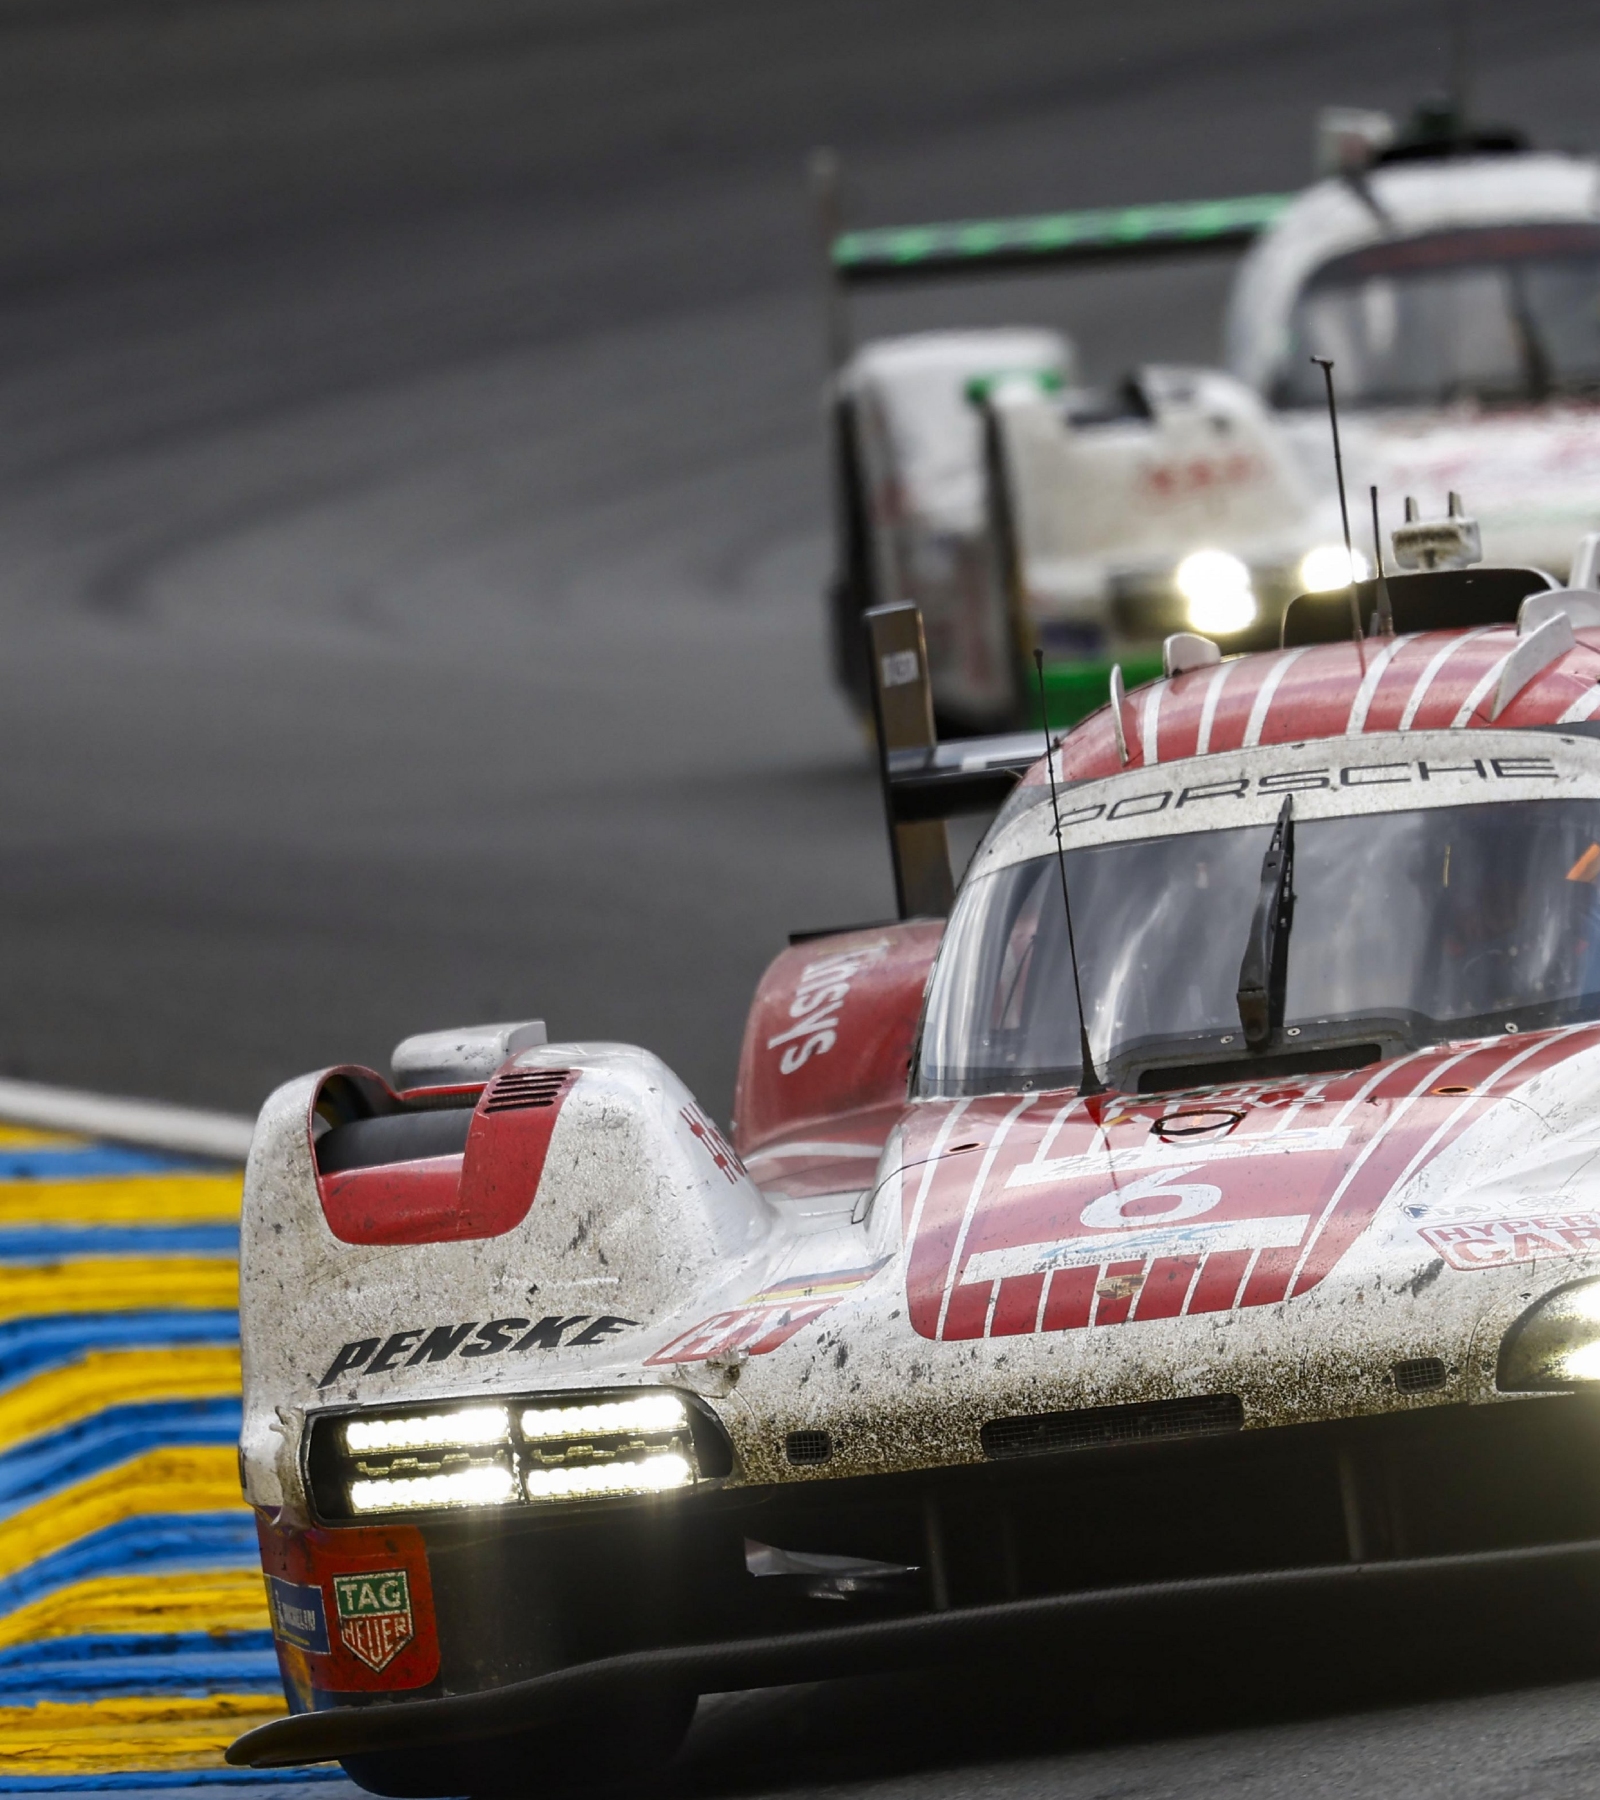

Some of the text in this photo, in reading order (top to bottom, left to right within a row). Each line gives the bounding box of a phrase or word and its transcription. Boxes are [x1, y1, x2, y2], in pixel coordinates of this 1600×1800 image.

[1050, 758, 1560, 837] PORSCHE
[1080, 1165, 1222, 1228] 6
[1433, 1214, 1598, 1243] HYPER
[316, 1315, 642, 1390] PENSKE
[340, 1579, 402, 1611] TAG
[344, 1617, 407, 1663] HEUER
